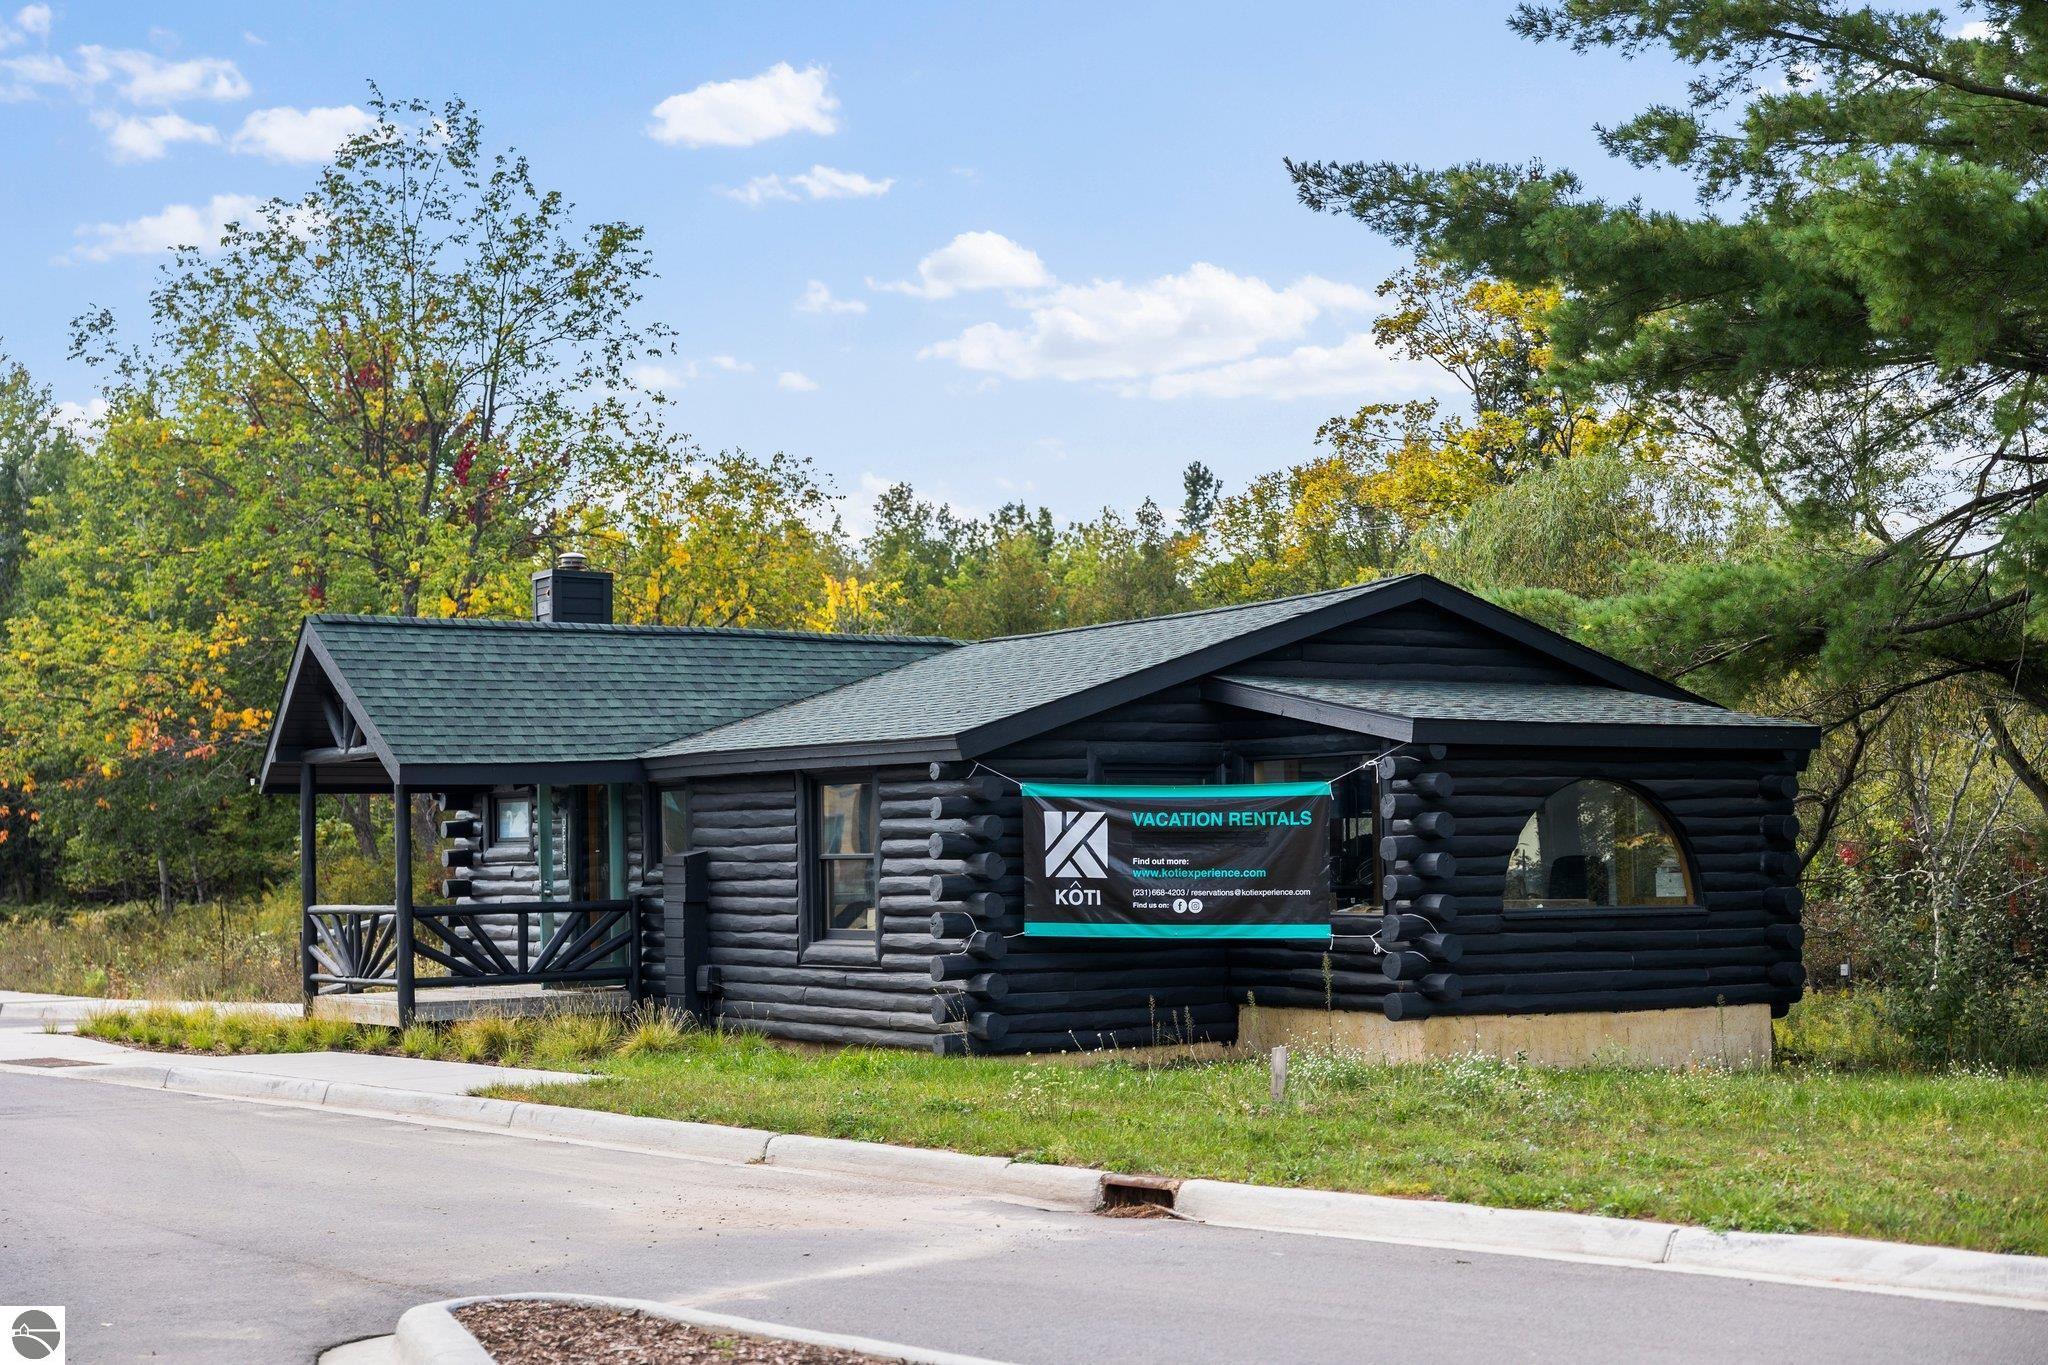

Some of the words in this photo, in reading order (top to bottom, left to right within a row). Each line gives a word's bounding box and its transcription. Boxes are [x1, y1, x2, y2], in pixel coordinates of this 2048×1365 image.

[1132, 811, 1223, 827] VACATION
[1228, 810, 1312, 826] RENTALS
[1132, 857, 1150, 866] Find
[1151, 858, 1165, 866] out
[1166, 858, 1190, 866] more:
[1132, 868, 1267, 880] www.kotiexperience.com
[1055, 880, 1101, 906] KÔTI
[1190, 887, 1311, 898] reservations@kotiexperience.com
[1132, 901, 1148, 909] Find
